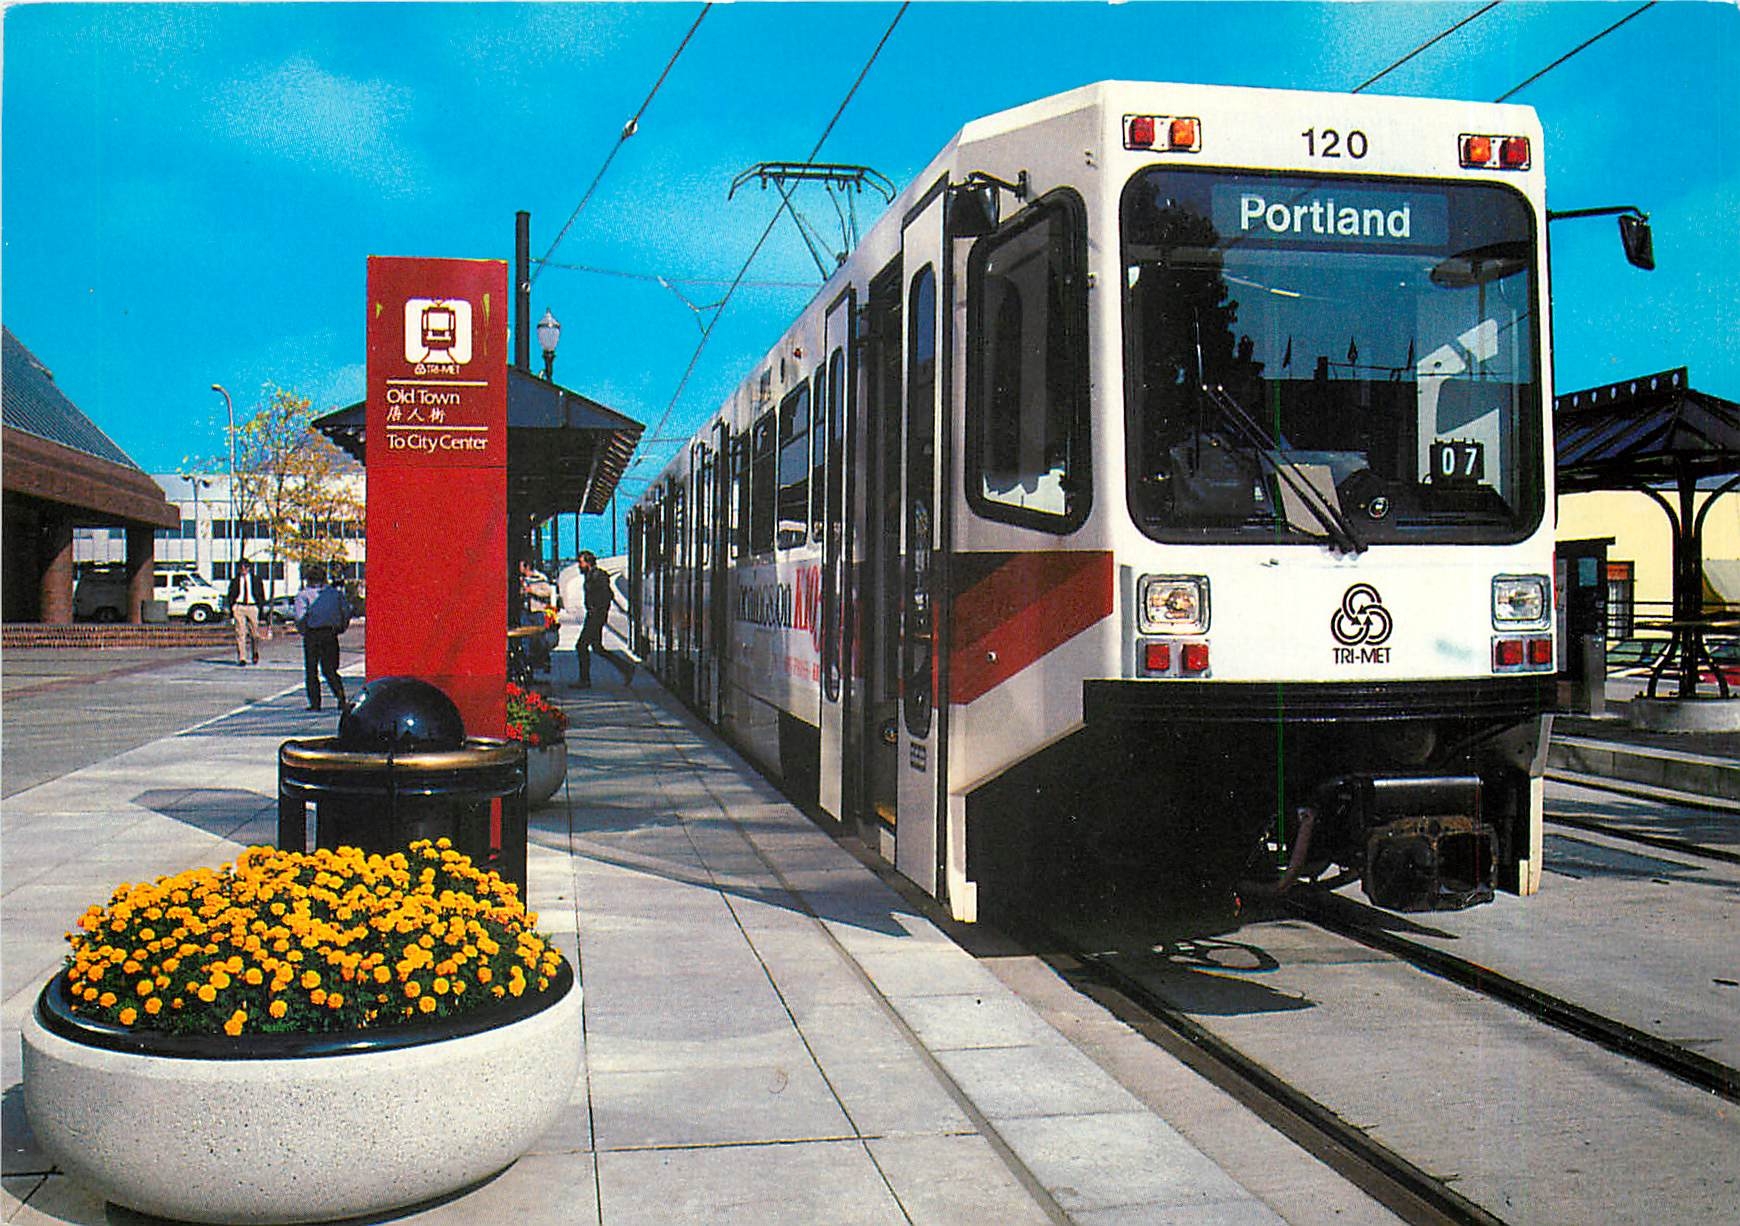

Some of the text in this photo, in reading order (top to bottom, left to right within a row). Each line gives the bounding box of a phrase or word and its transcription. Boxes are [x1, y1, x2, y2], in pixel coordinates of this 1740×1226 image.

[1302, 127, 1368, 159] 120
[1239, 193, 1411, 239] Portland
[386, 388, 460, 405] Old Town
[386, 434, 489, 454] To City Center
[1441, 447, 1478, 476] 07
[1331, 647, 1392, 664] TRI-MET
